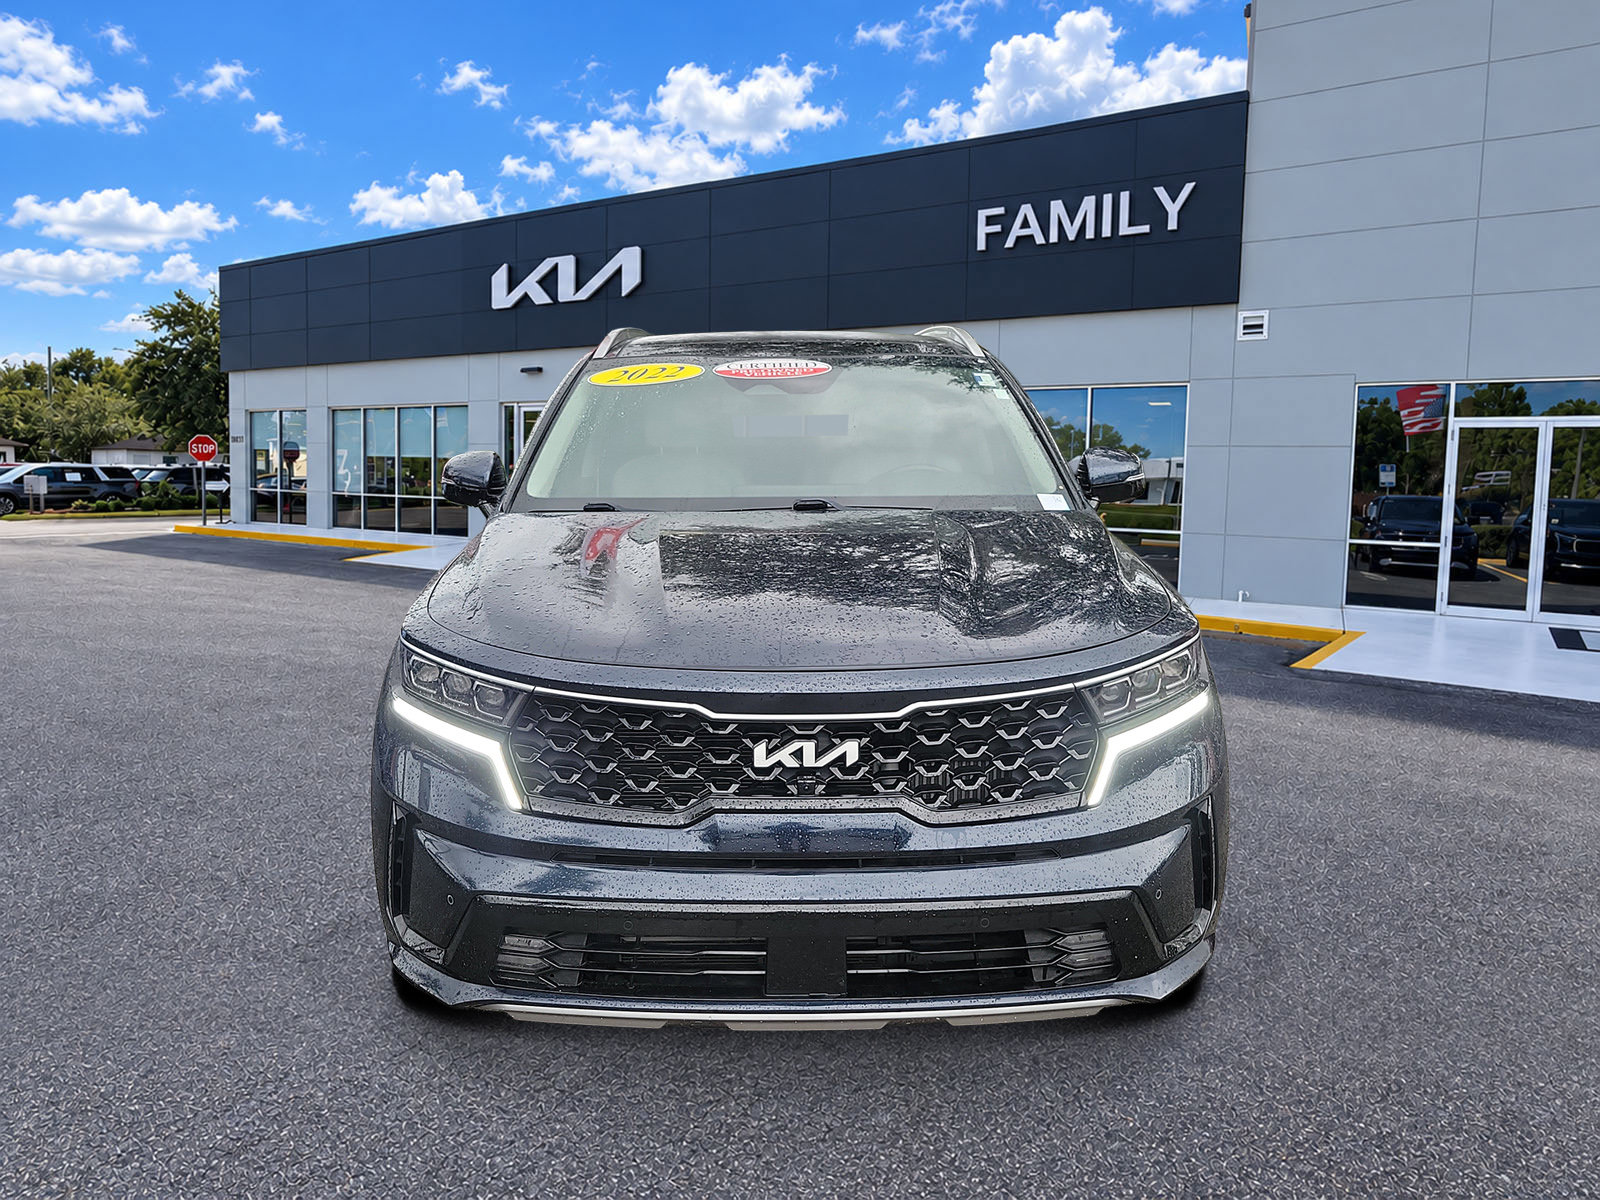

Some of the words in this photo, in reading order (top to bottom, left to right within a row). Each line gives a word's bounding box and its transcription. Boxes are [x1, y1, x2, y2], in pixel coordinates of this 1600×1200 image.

[976, 181, 1197, 252] FAMILY
[491, 246, 642, 310] KIA
[608, 366, 684, 383] 2022
[191, 444, 215, 454] STOP
[752, 739, 860, 768] KIA
